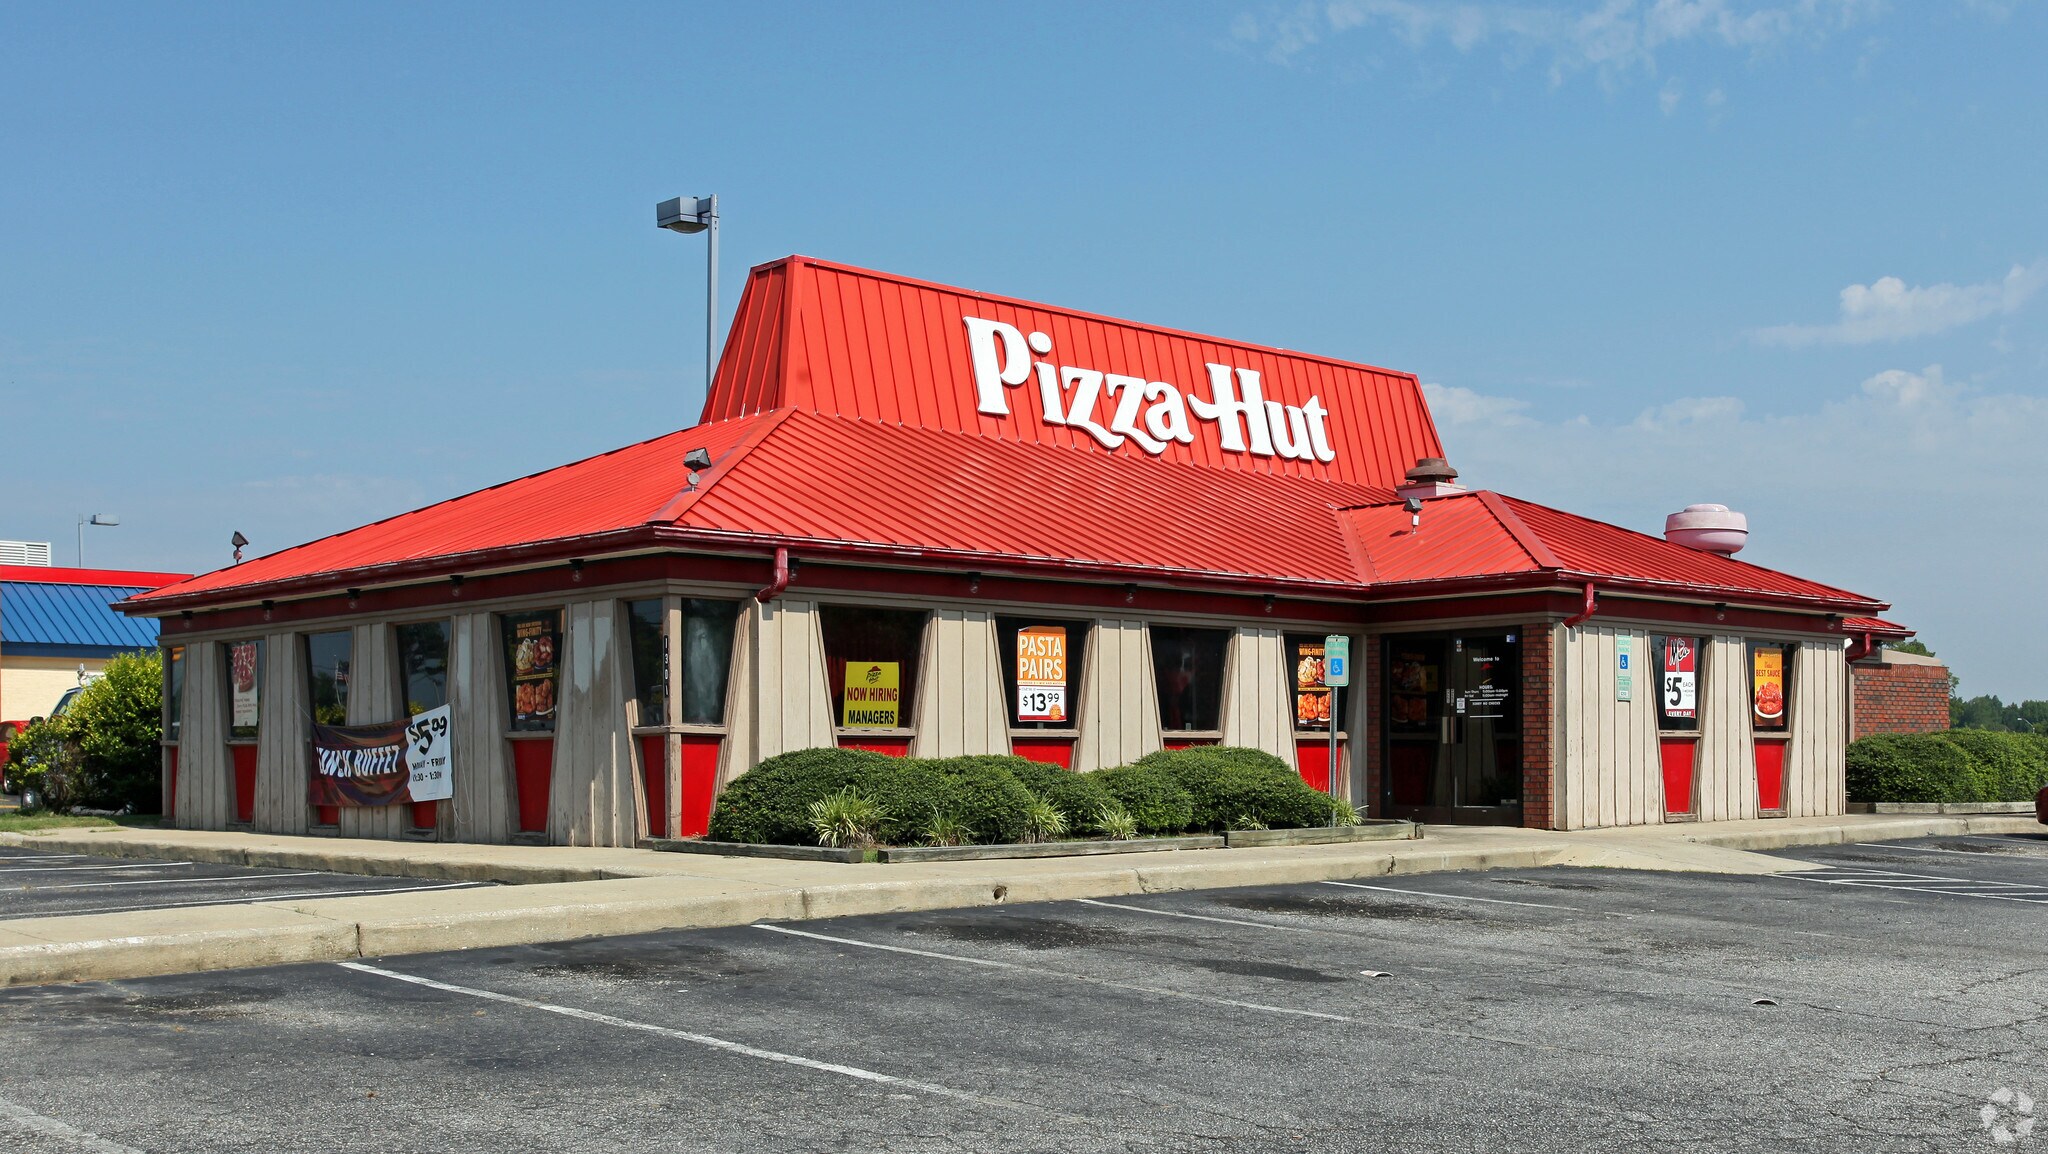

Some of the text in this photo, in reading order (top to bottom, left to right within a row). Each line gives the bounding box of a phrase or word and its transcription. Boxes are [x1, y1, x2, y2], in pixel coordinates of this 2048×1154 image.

[963, 316, 1335, 463] Pizza Hut
[1019, 635, 1063, 657] PASTA
[1019, 658, 1063, 680] PAIRS
[847, 687, 898, 702] NOW HIRING
[1665, 677, 1682, 706] $5
[848, 710, 895, 724] MANAGERS
[353, 744, 400, 777] BUFFET
